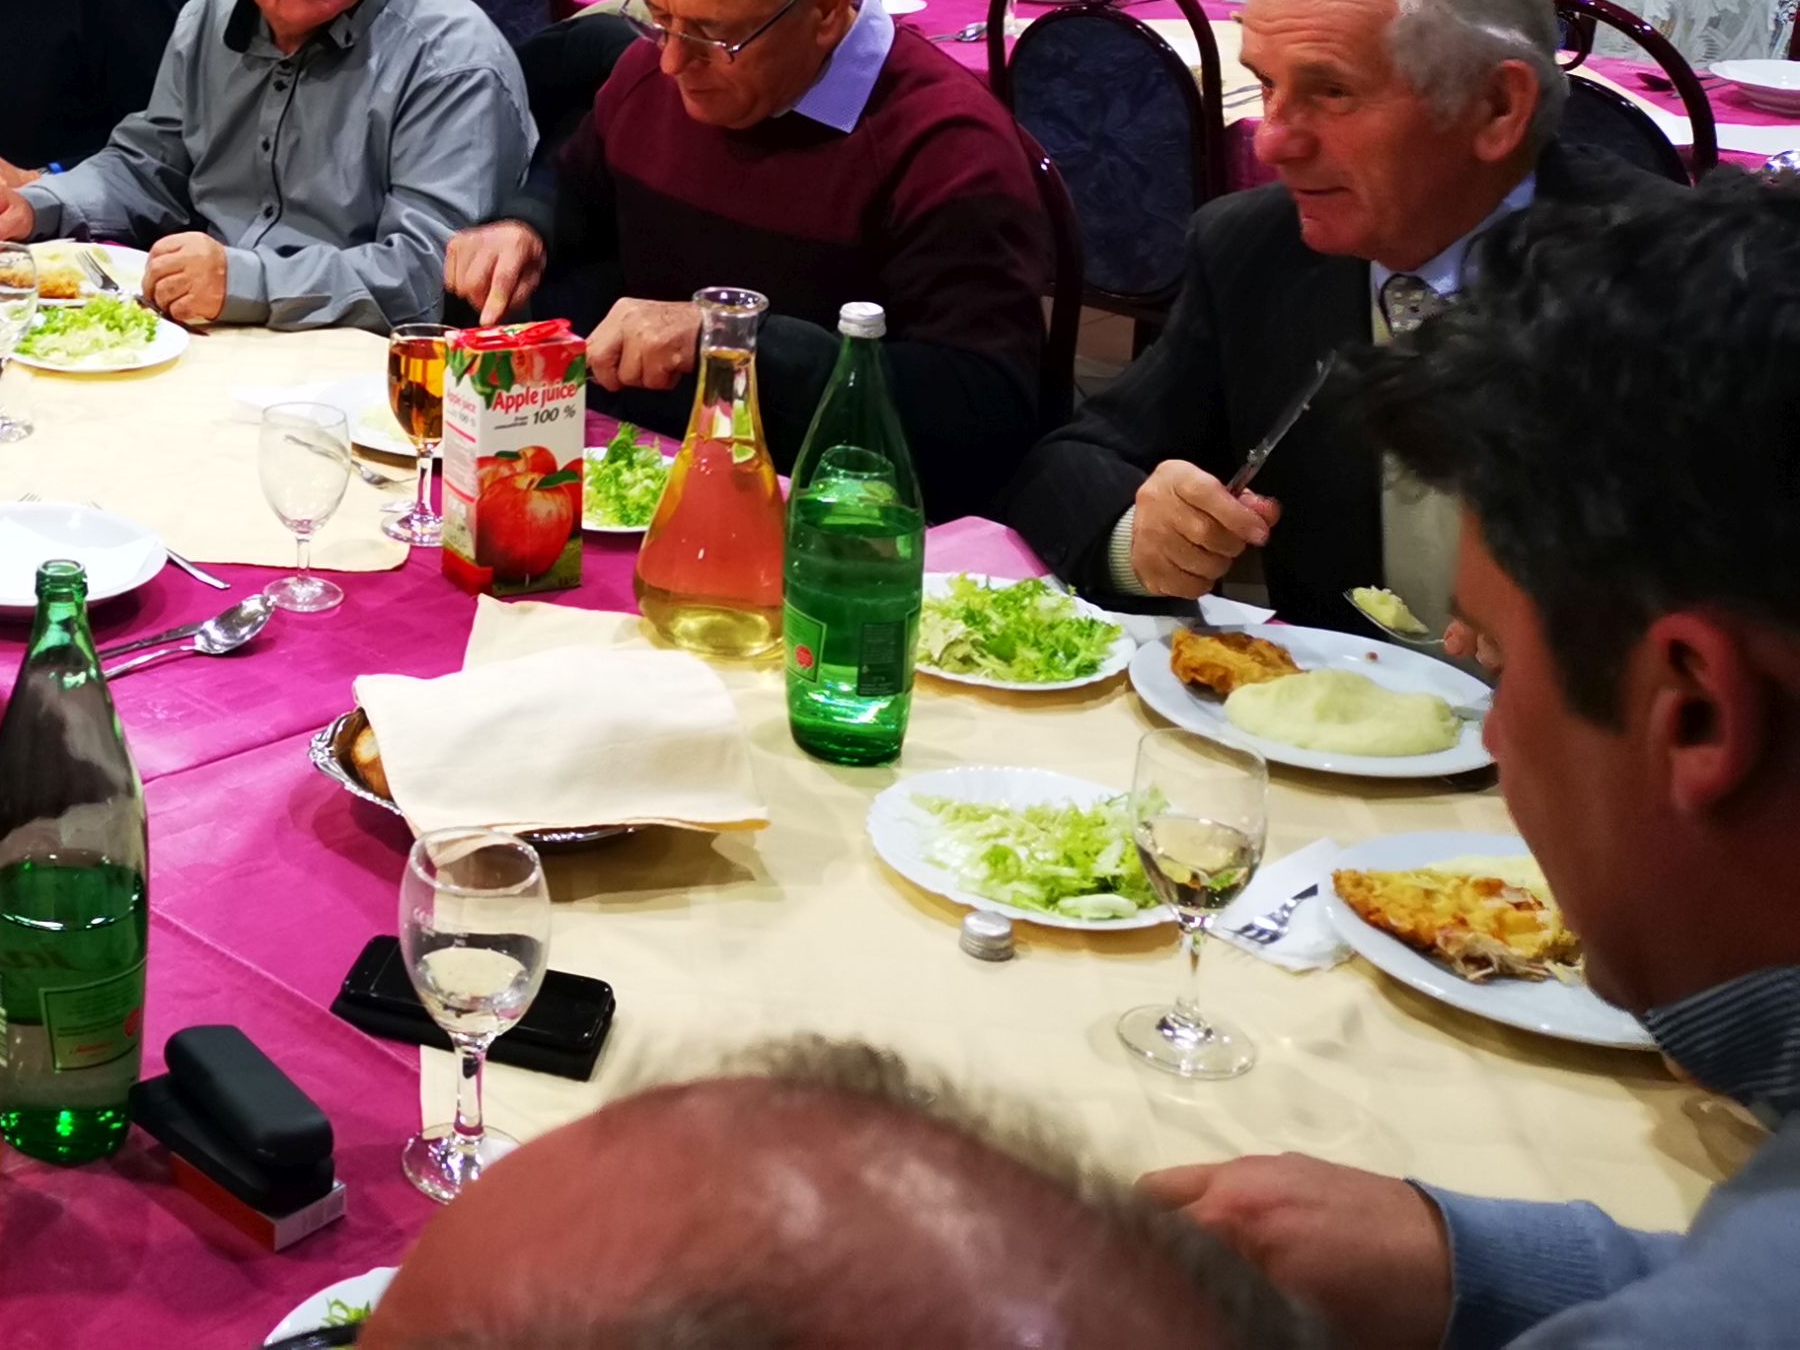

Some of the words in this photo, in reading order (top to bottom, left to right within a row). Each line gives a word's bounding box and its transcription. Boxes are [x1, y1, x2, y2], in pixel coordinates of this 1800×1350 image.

[492, 385, 539, 415] Apple
[539, 381, 578, 409] juice
[533, 407, 560, 425] 100
[562, 404, 577, 419] %
